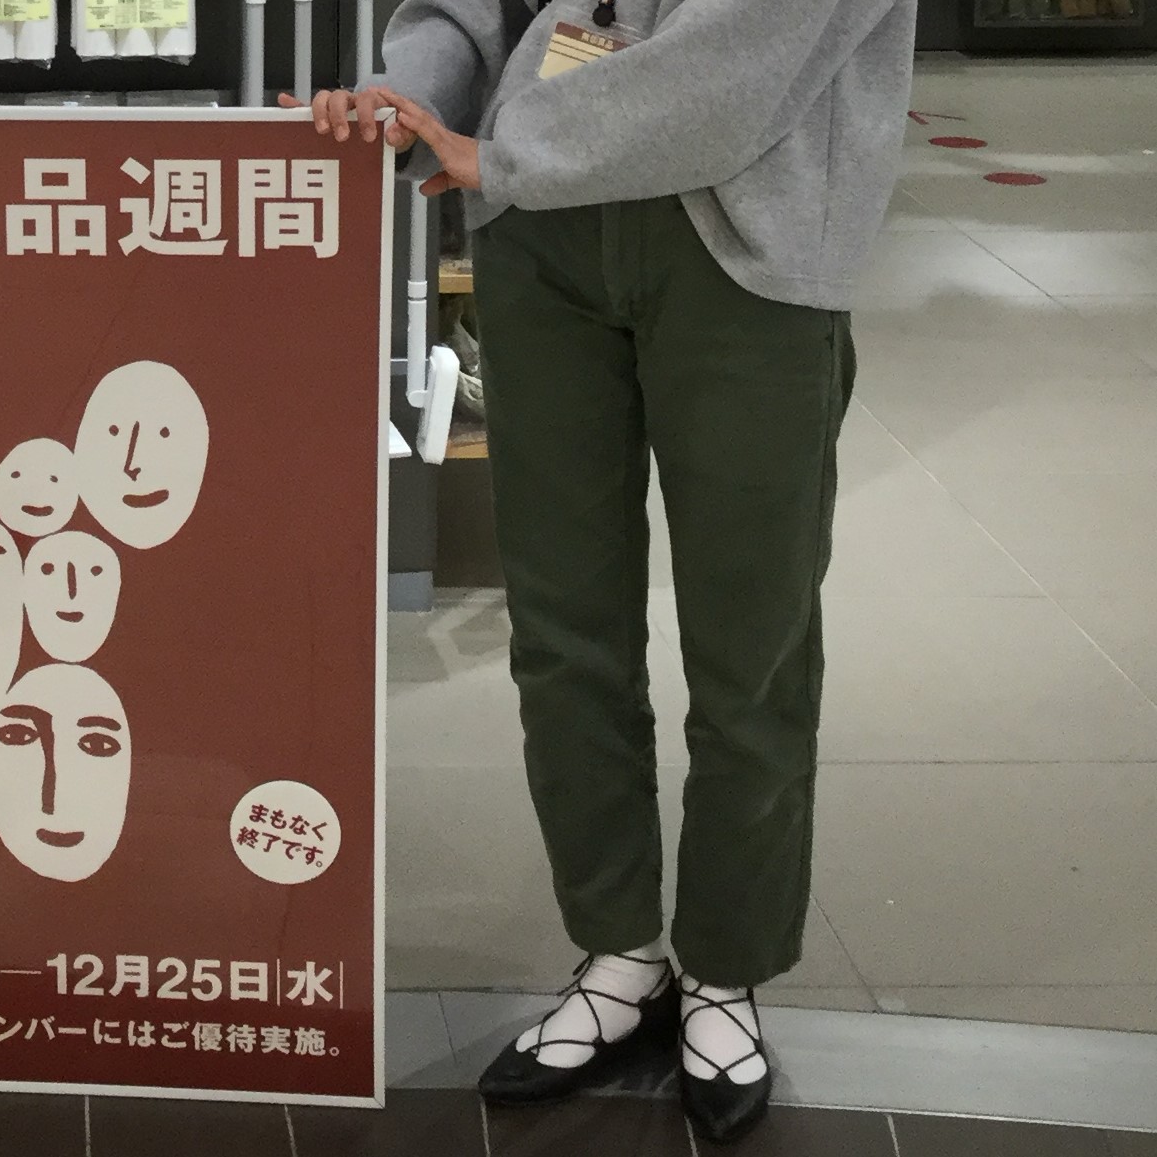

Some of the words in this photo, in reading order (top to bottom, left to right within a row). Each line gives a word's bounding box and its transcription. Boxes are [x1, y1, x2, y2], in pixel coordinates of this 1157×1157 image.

[249, 804, 327, 841] まもなく
[237, 826, 323, 867] 終了です。
